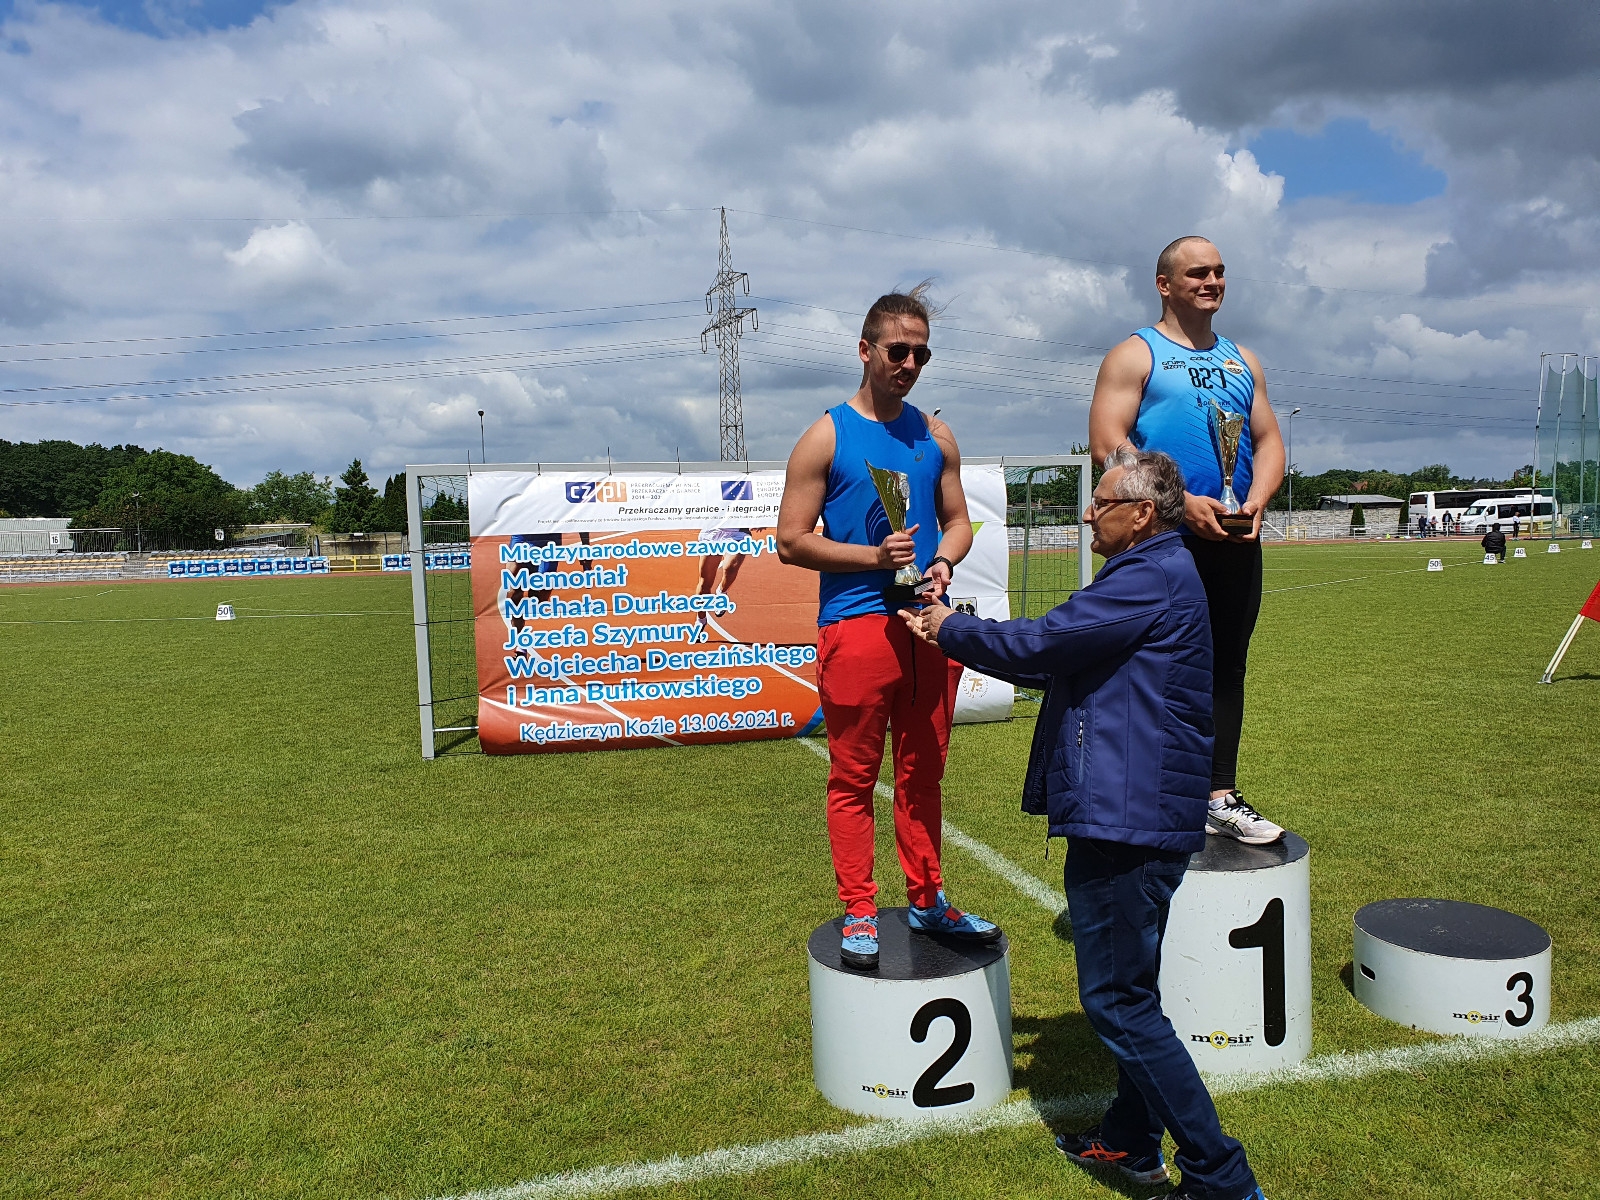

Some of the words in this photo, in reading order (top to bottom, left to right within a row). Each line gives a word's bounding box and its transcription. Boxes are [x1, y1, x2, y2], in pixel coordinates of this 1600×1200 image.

[1187, 367, 1227, 389] 827
[618, 506, 683, 515] Przekraczamy
[685, 505, 720, 514] granice
[501, 540, 682, 563] Międzynarodowe
[687, 537, 762, 556] zawody
[1429, 560, 1439, 568] 50
[502, 565, 627, 590] Memoriał
[217, 606, 229, 615] 50
[504, 596, 606, 618] Michała
[614, 592, 735, 614] Durkacza,
[505, 625, 586, 648] Józefa
[594, 624, 708, 646] Szymury,
[506, 652, 639, 679] Wojciecha
[647, 644, 816, 670] Derezińskiego
[508, 686, 515, 706] i
[522, 685, 579, 705] Jana
[586, 675, 761, 701] Bułkowskiego
[521, 723, 620, 743] Kędzierzyn
[626, 716, 675, 736] Koźle
[680, 711, 777, 733] 13.06.2021
[783, 713, 795, 727] r.
[850, 924, 872, 934] NIKE
[1228, 897, 1287, 1047] 1
[1505, 971, 1534, 1027] 3
[1452, 1010, 1501, 1024] mosir
[1190, 1030, 1254, 1049] mosir
[909, 997, 975, 1108] 2
[861, 1083, 909, 1098] mosir
